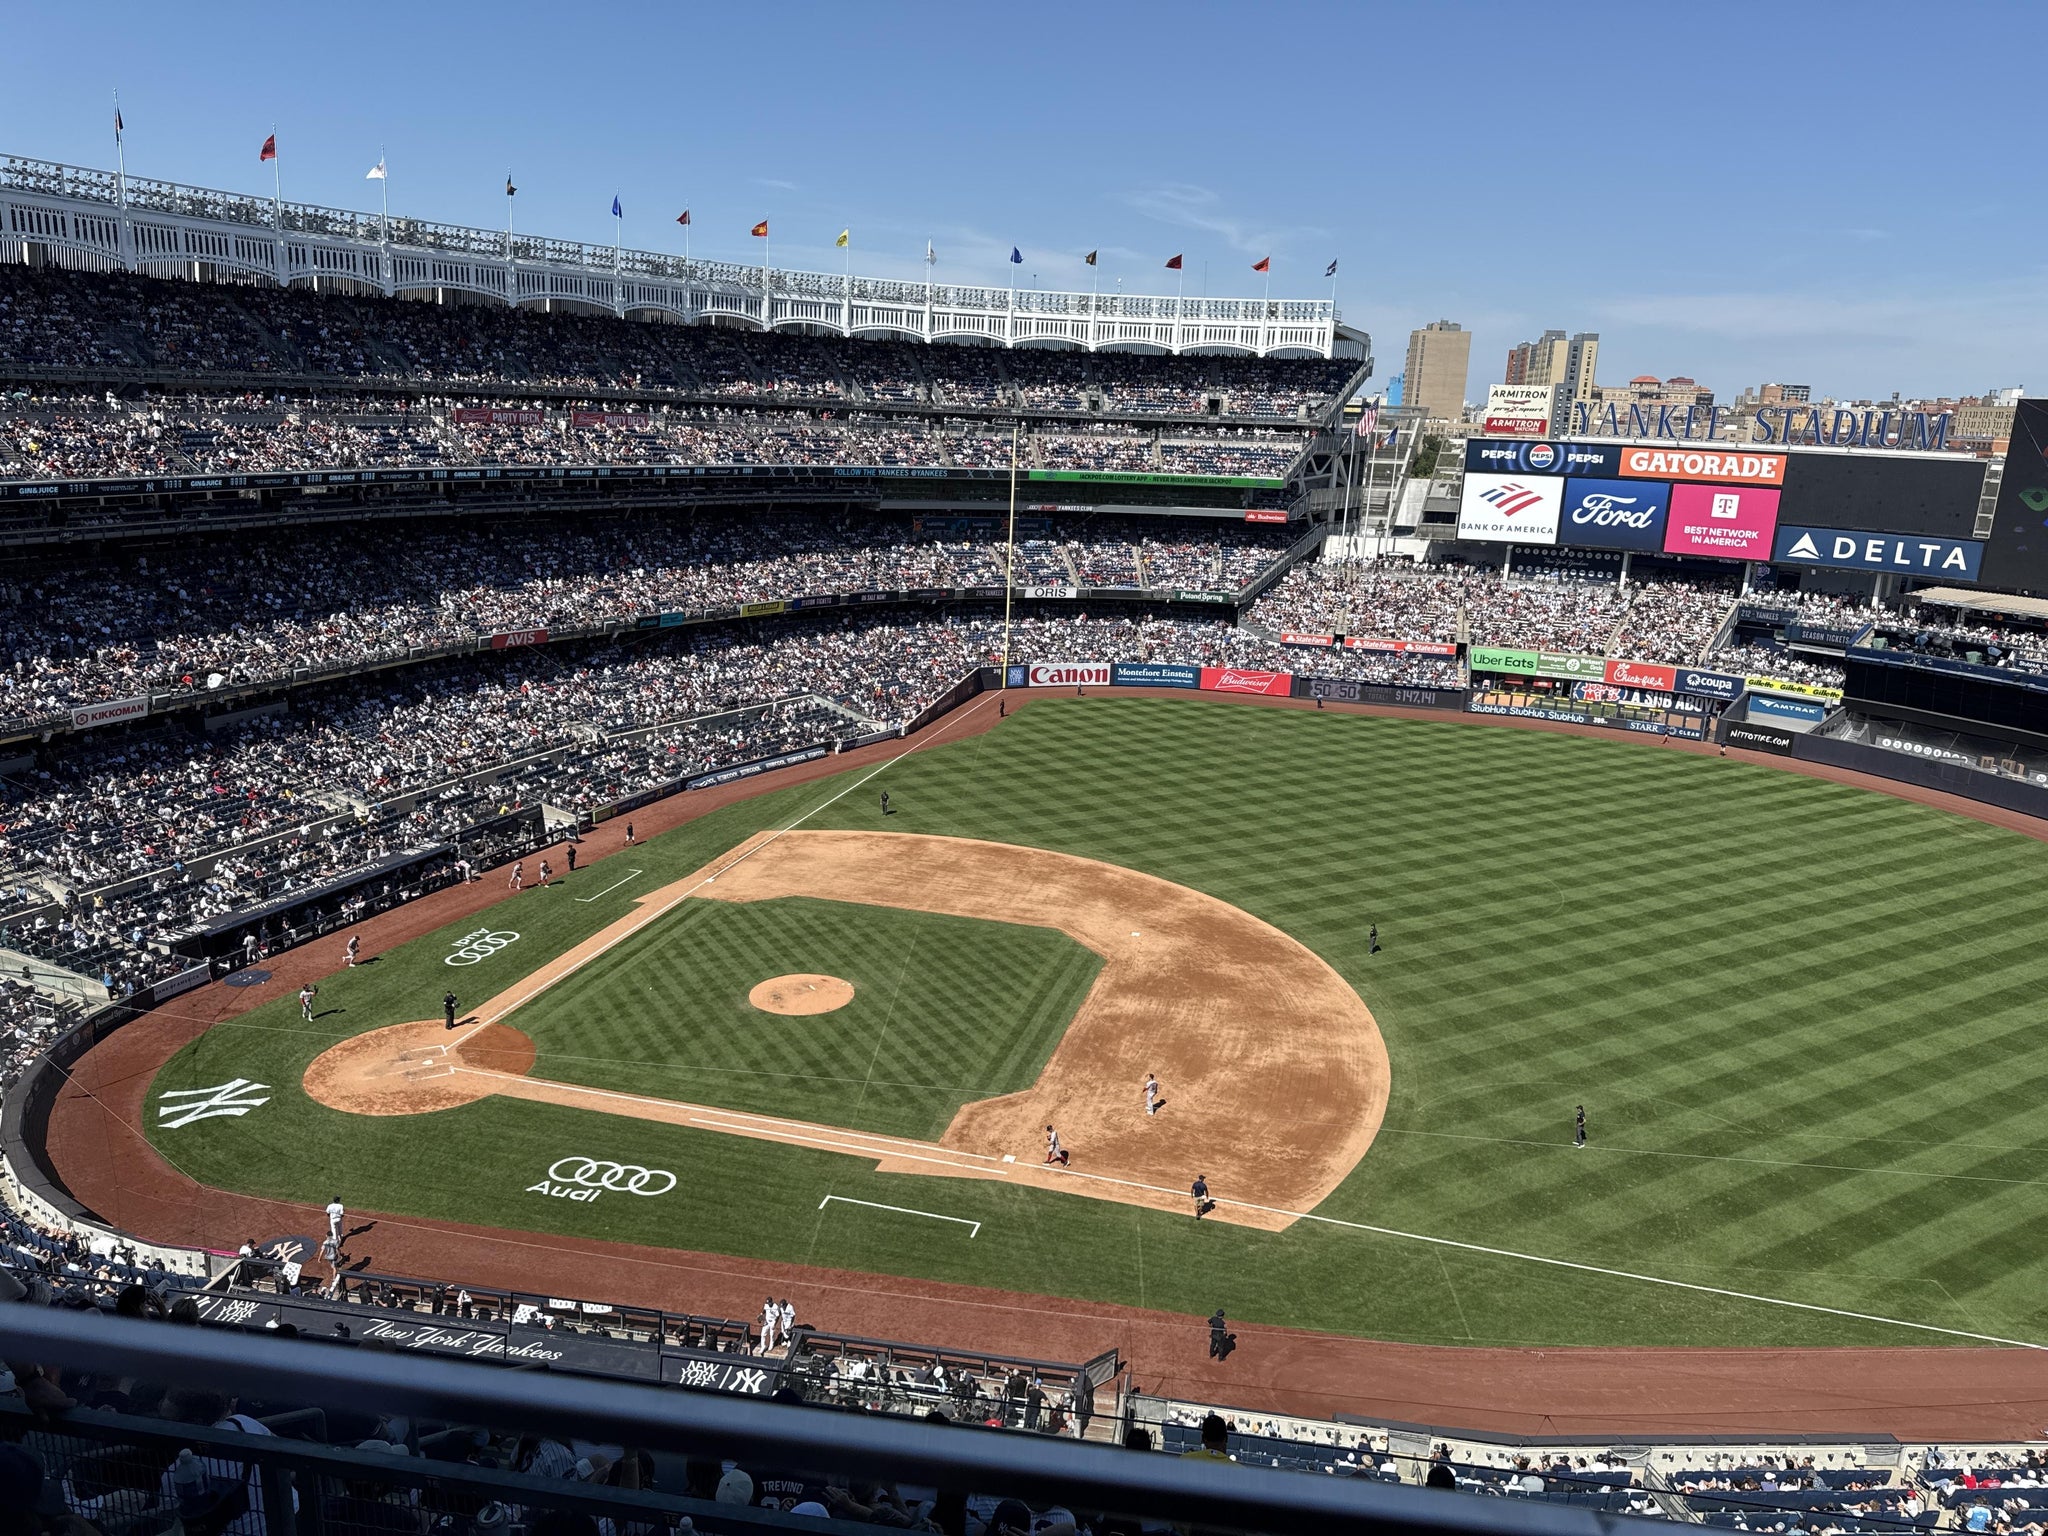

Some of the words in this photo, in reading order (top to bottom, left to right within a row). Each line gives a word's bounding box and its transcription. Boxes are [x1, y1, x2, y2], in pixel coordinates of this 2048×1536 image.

[1492, 389, 1548, 399] ARMITRON
[492, 411, 518, 422] PARTY
[519, 412, 540, 424] DECK
[604, 415, 627, 425] PARTY
[1491, 419, 1541, 428] ARMITRON
[1575, 401, 1729, 441] YANKEE
[1752, 407, 1952, 450] STADIUM
[1481, 450, 1517, 460] PEPSI
[1531, 452, 1552, 460] PEPSI
[1567, 454, 1604, 464] PEPSI
[1629, 451, 1778, 479] GATORADE
[878, 469, 909, 477] YANKEES
[911, 470, 948, 478] @YANKEES
[1572, 493, 1657, 529] Ford
[1719, 498, 1733, 514] T
[1460, 522, 1488, 531] BANK
[1491, 524, 1504, 532] OF
[1506, 525, 1554, 535] AMERICA
[1684, 525, 1708, 535] BEST
[1709, 527, 1759, 539] NETWORK
[1691, 535, 1701, 543] IN
[1702, 536, 1748, 548] AMERICA
[1832, 537, 1967, 571] DELTA
[1035, 587, 1067, 597] ORIS
[1180, 591, 1200, 600] Poland
[1201, 592, 1223, 602] Spring
[1756, 612, 1779, 620] YANKEES
[505, 631, 536, 646] AVIS
[1801, 630, 1825, 640] SEASON
[1826, 634, 1850, 644] TICKETS
[1473, 653, 1502, 665] Uber
[1504, 656, 1535, 669] Eats
[1030, 666, 1108, 684] Canon
[1118, 667, 1161, 677] Montefiore
[1162, 669, 1193, 679] Einstein
[1223, 675, 1269, 687] Budweiser
[1701, 677, 1732, 690] coupa
[1748, 679, 1774, 689] Gillette
[1340, 685, 1356, 699] 50
[1780, 684, 1807, 694] Gillette
[1812, 689, 1840, 699] Gillette
[1395, 689, 1436, 704] $147,141
[1631, 690, 1640, 703] A
[1644, 690, 1672, 708] SUB
[91, 704, 144, 721] KIKKOMAN
[1471, 703, 1507, 714] StubHub
[1509, 707, 1545, 718] StubHub
[1773, 703, 1816, 714] AMTRAK
[1547, 711, 1584, 723] StubHub
[1629, 722, 1659, 733] STARR
[1730, 729, 1790, 748] NITTOTIRE.COM
[238, 895, 288, 915] Stadium
[451, 927, 490, 947] Audi
[158, 1078, 271, 1128] NY
[525, 1180, 602, 1202] Audi
[228, 1299, 261, 1309] NEW
[221, 1306, 258, 1318] YORK
[362, 1318, 415, 1340] New
[407, 1326, 478, 1348] York
[465, 1333, 563, 1361] Yankees
[686, 1360, 720, 1371] NEW
[681, 1368, 719, 1382] YORK
[728, 1367, 768, 1394] NY
[761, 1480, 804, 1495] TREVINO
